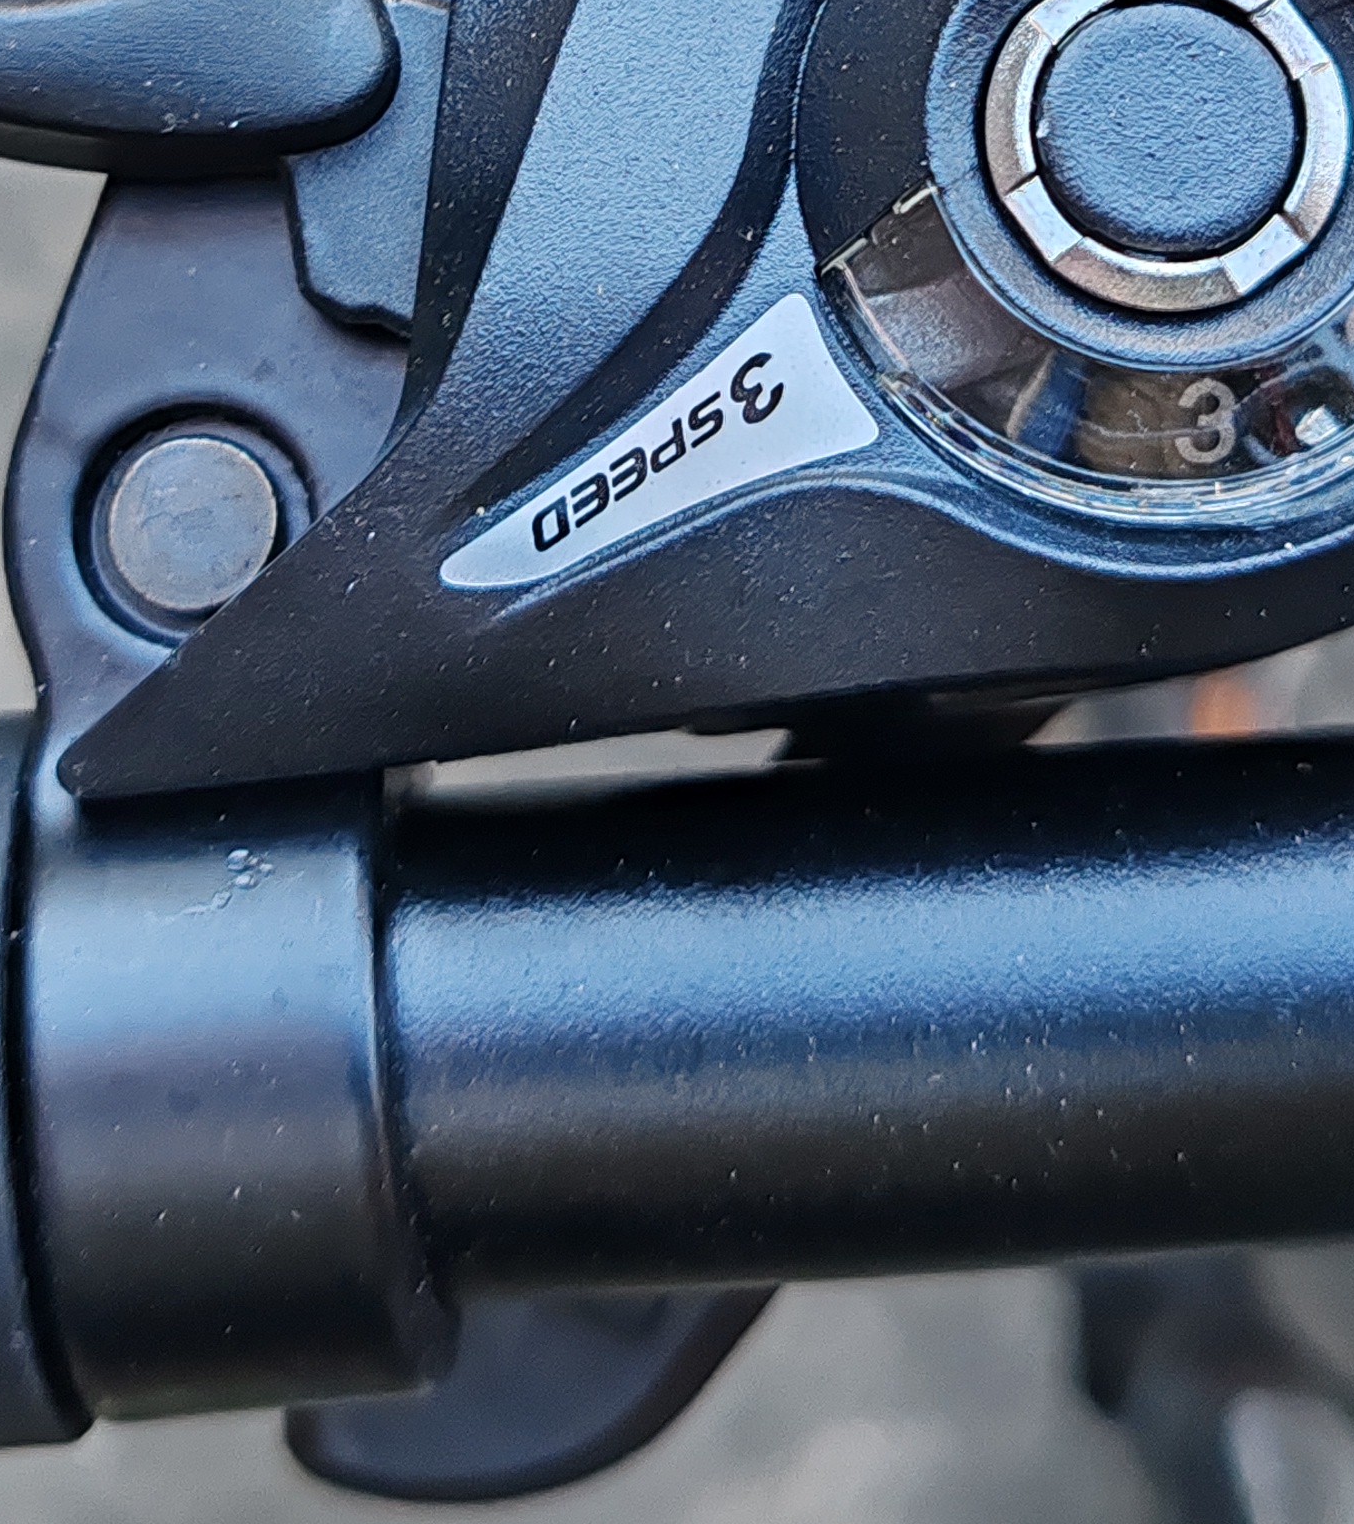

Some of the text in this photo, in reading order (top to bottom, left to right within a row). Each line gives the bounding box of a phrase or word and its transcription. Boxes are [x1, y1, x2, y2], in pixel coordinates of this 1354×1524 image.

[531, 351, 785, 553] 3 SPEED
[1175, 378, 1235, 463] 3
